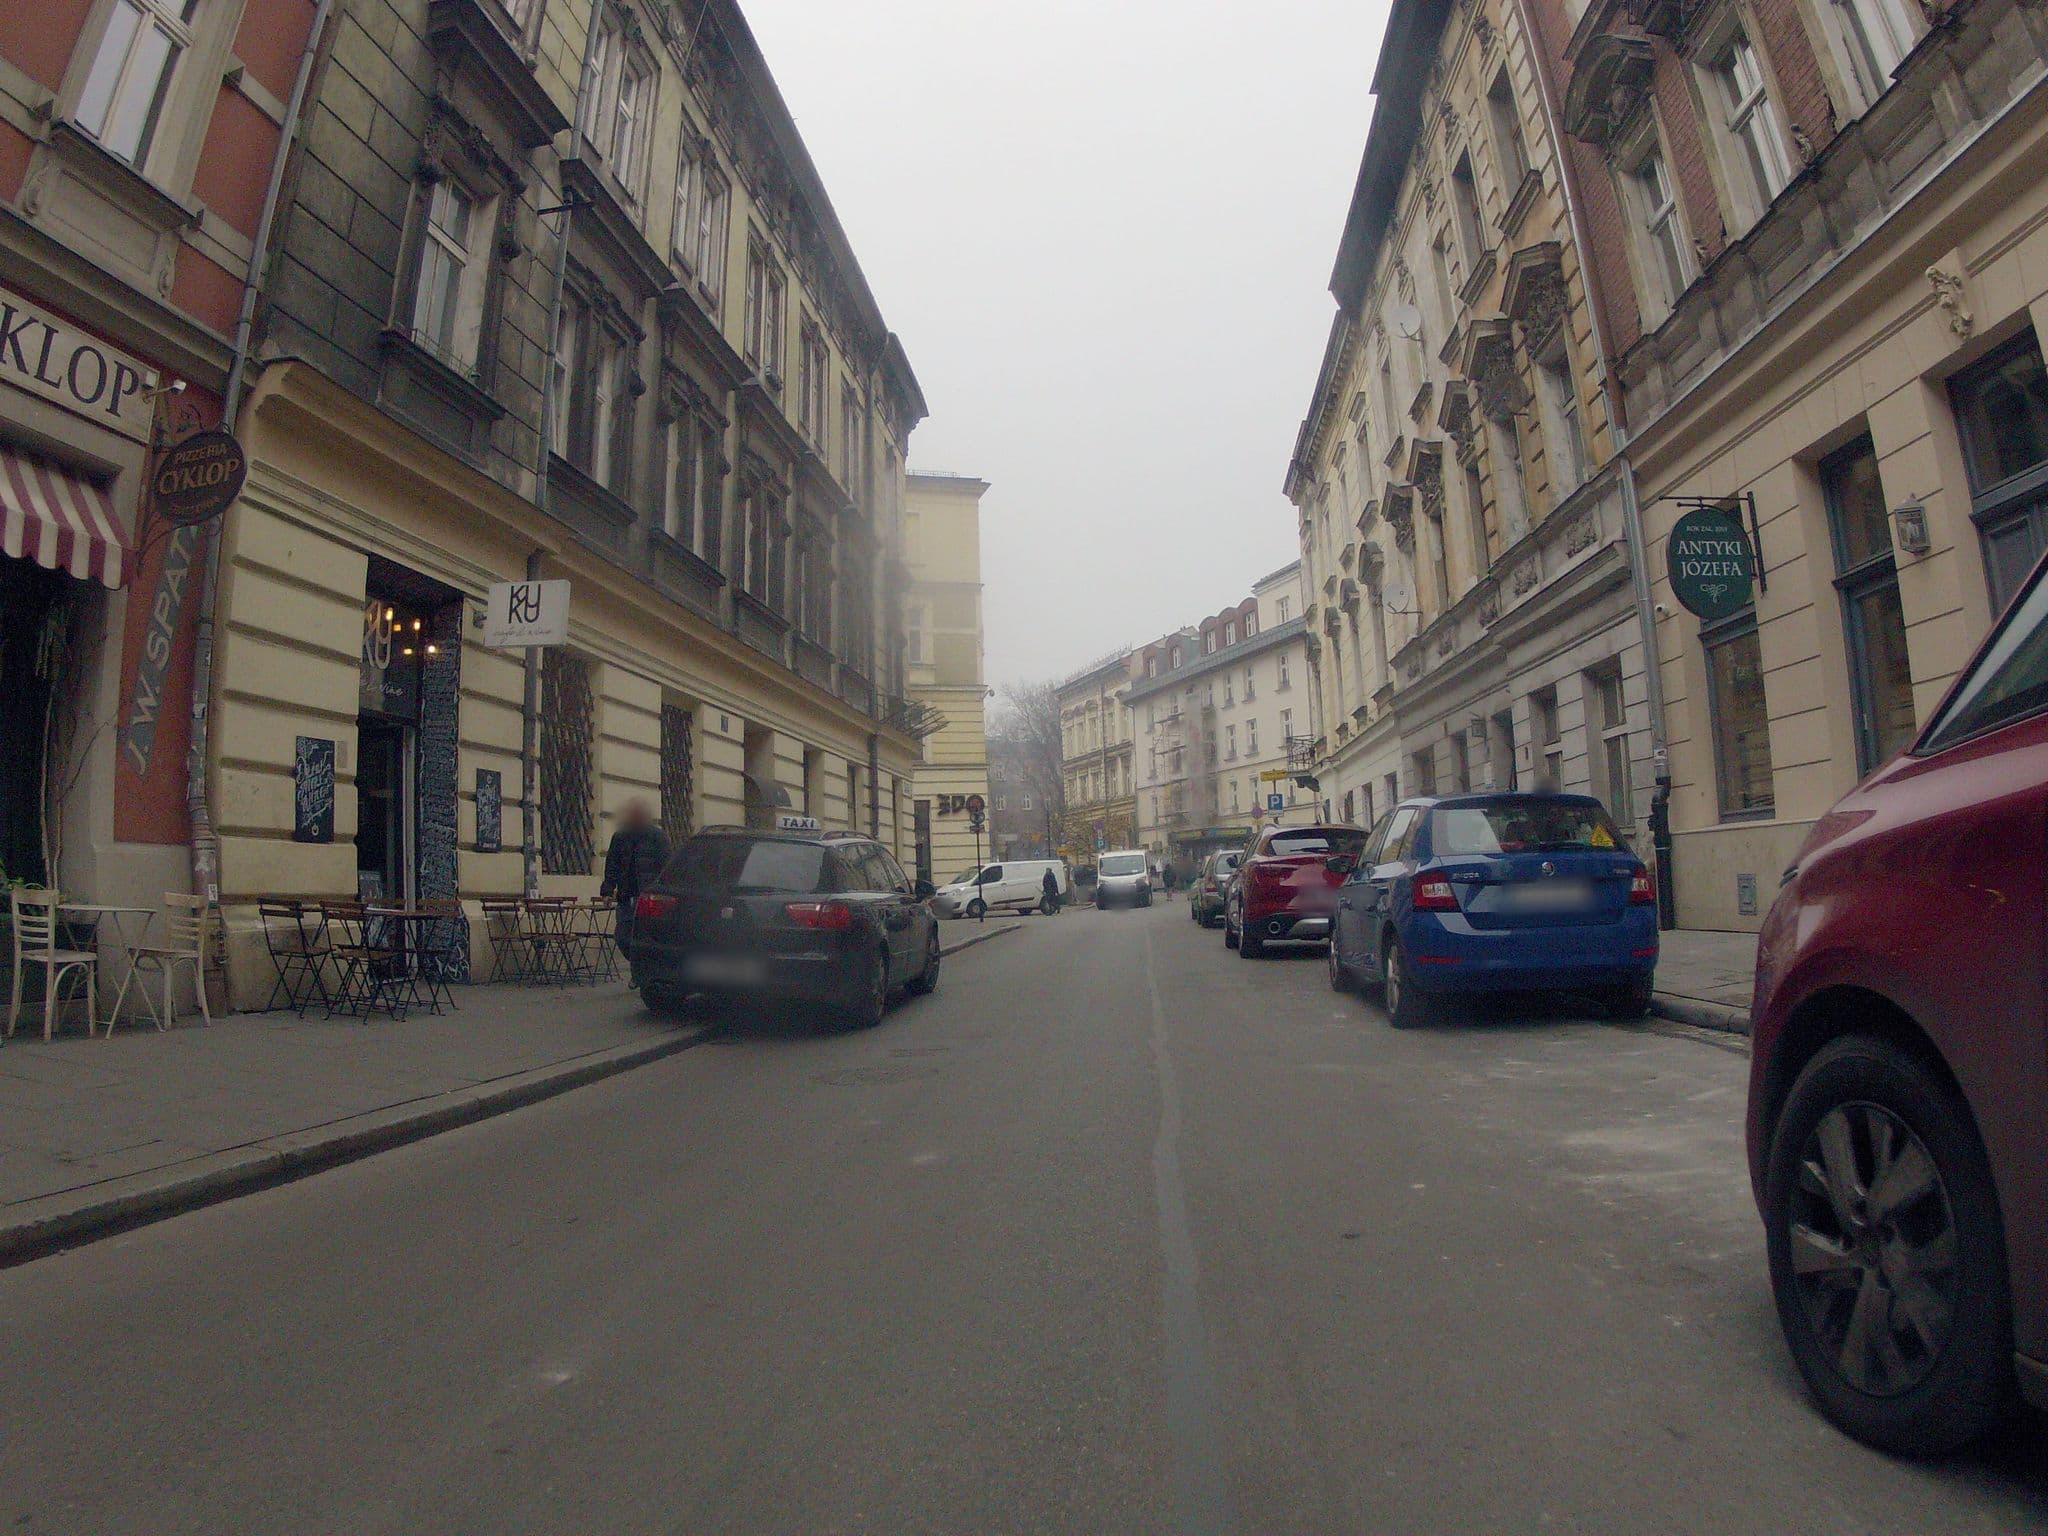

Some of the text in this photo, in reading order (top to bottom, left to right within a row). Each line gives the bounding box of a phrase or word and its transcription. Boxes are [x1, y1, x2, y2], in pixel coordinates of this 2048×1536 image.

[159, 458, 240, 494] CYKLOP
[1677, 540, 1743, 556] ANTYKI
[1681, 558, 1744, 579] JÓZEFA
[1271, 796, 1280, 808] P
[783, 817, 815, 828] TAXI
